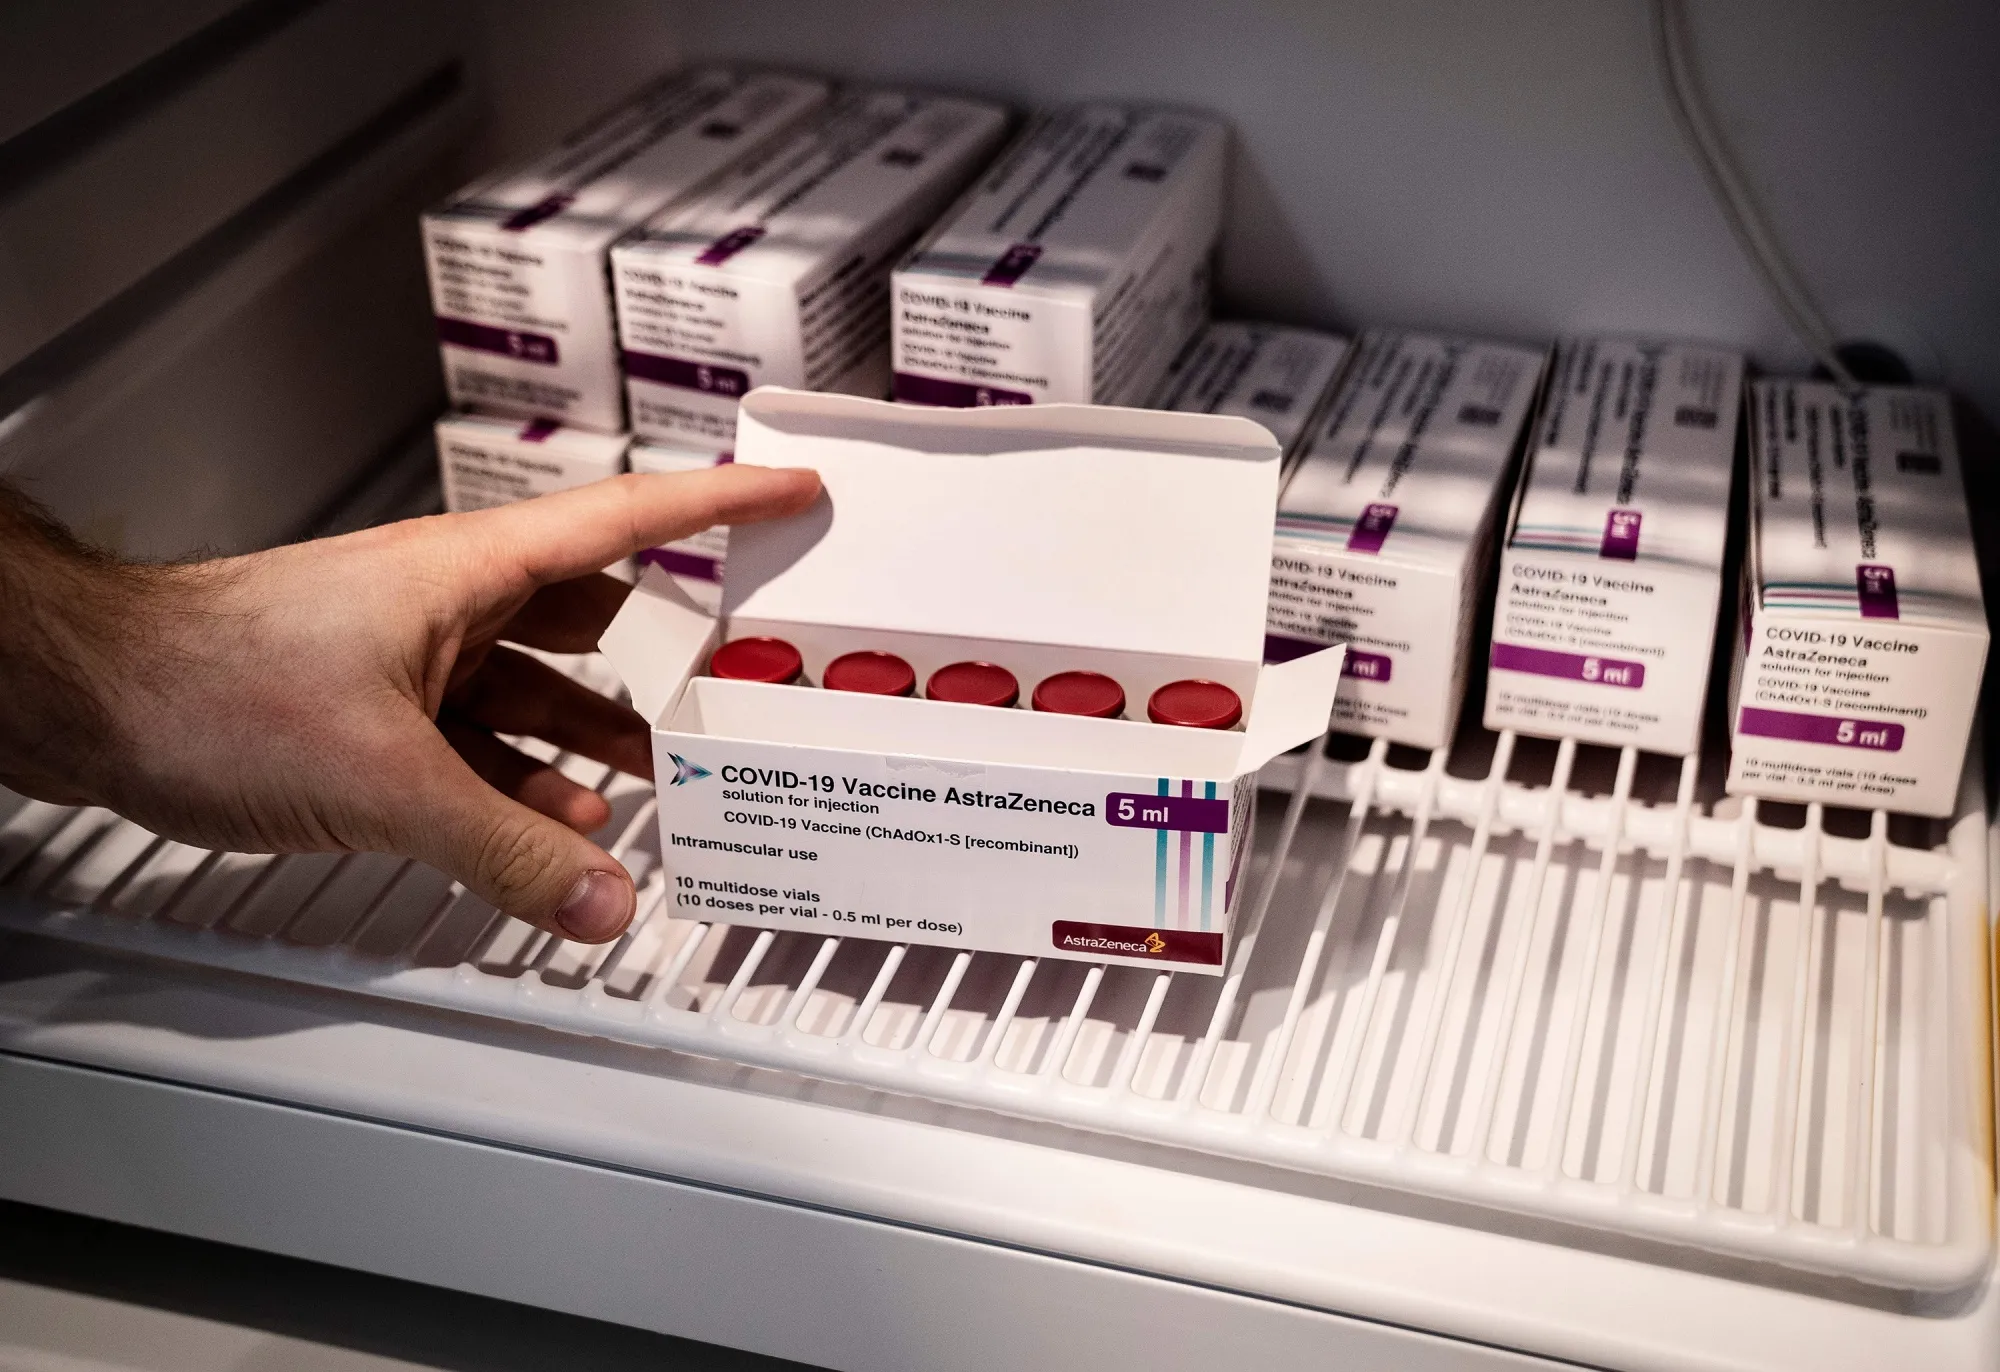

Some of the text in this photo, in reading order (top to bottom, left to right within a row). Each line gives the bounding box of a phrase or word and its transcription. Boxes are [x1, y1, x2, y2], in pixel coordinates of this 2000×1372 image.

[1271, 557, 1397, 588] OVID-19 Vaccine
[1512, 563, 1655, 595] COVID-19 Vaccine
[1270, 576, 1353, 600] straZeneca
[1510, 583, 1608, 607] AstraZeneca
[1766, 627, 1919, 655] COVID-19 Vaccine
[1581, 657, 1632, 685] 5 ml
[1763, 646, 1868, 669] AstraZeneca
[1760, 661, 1890, 684] solution for injection
[1758, 676, 1871, 698] COVID-19 Vaccine
[1836, 720, 1888, 747] 5 ml
[721, 765, 1096, 817] COVID-19 Vaccine AstraZeneca
[722, 788, 880, 815] solution for injection
[1117, 798, 1169, 823] 5 ml
[671, 833, 818, 862] Intramuscular use
[724, 810, 1080, 859] COVID-19 Vaccine (ChAdOx1-S [recombinant])
[675, 876, 821, 903] 10 multidose vials
[676, 893, 701, 907] (10
[705, 896, 755, 912] doses
[759, 902, 785, 916] per
[789, 905, 818, 919] vial
[832, 909, 856, 923] 0.5
[861, 913, 881, 926] ml
[885, 916, 913, 929] per
[917, 918, 963, 935] dose)
[1063, 934, 1147, 953] AstraZeneca
